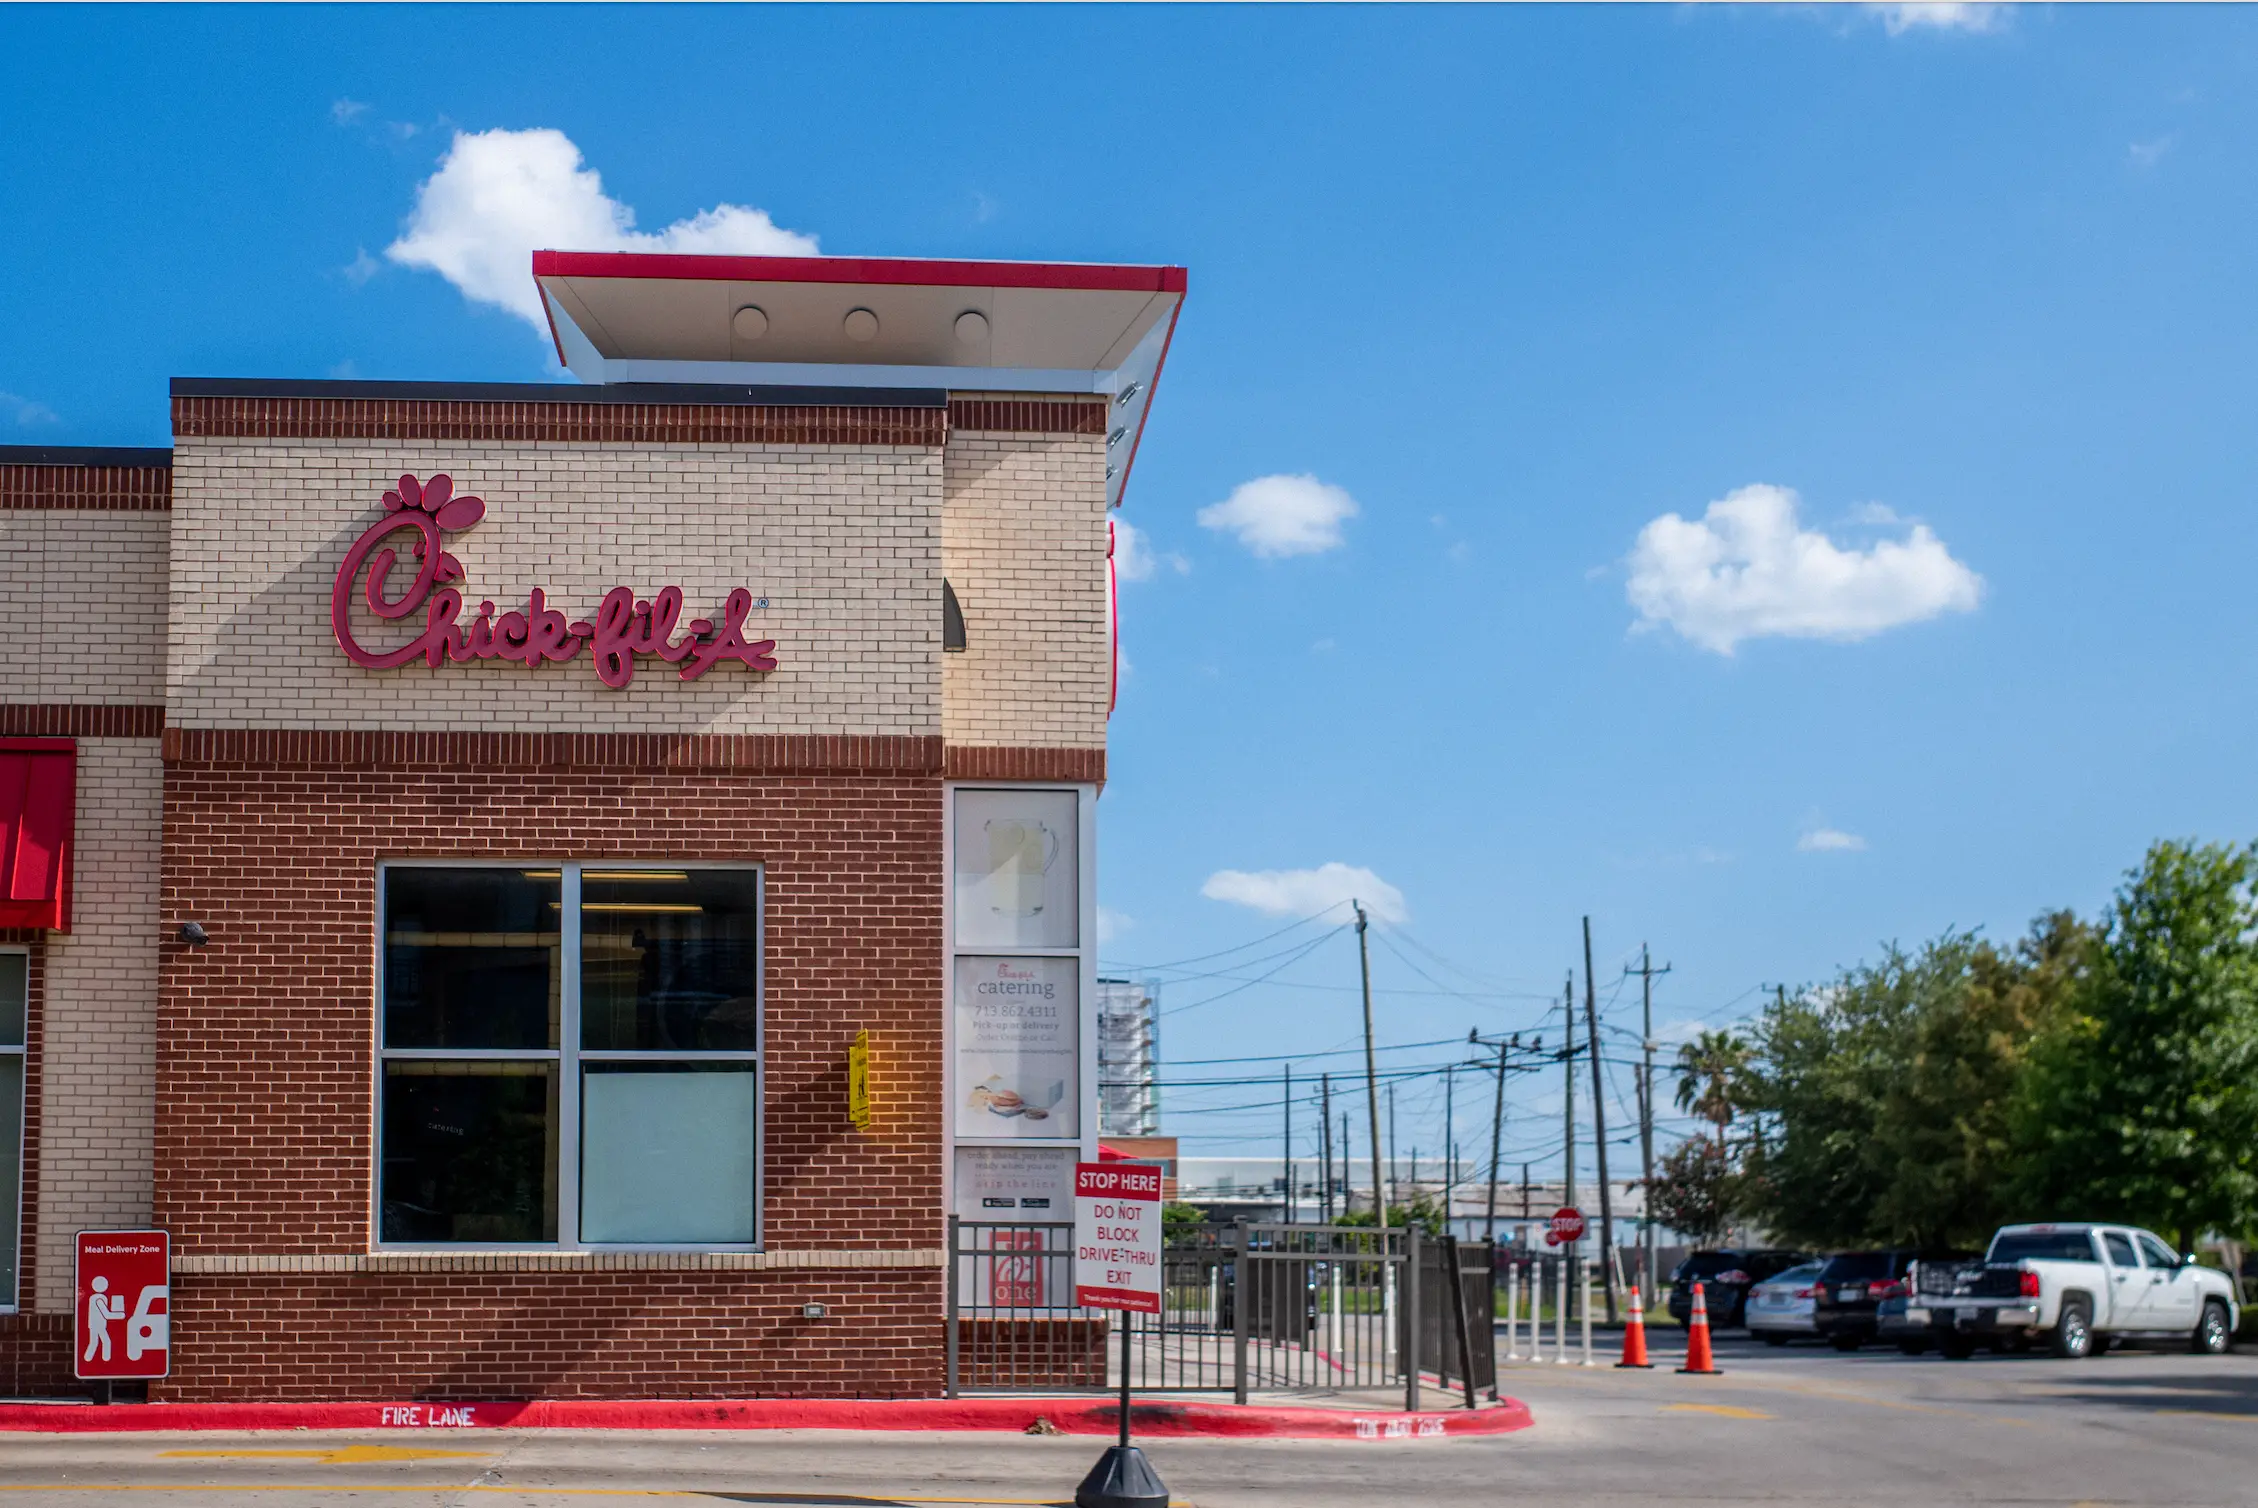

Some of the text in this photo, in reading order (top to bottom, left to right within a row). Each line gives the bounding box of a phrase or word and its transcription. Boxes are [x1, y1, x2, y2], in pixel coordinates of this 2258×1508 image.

[332, 474, 777, 688] Chick-fil-A
[977, 979, 1055, 999] catering
[975, 1005, 1057, 1018] 713.862.4311
[973, 1021, 1008, 1031] Pick-up
[1022, 1021, 1060, 1031] delivery
[1079, 1171, 1158, 1192] STOP HERE
[1094, 1204, 1142, 1221] DO NOT
[1551, 1217, 1583, 1233] STOP
[1097, 1226, 1139, 1243] BLOCK
[84, 1244, 160, 1255] Meal Delivery Zone
[1080, 1246, 1156, 1266] DRIVE-THRU
[1106, 1269, 1132, 1285] EXIT
[995, 1285, 1037, 1300] one
[381, 1406, 475, 1427] FIRE LANE
